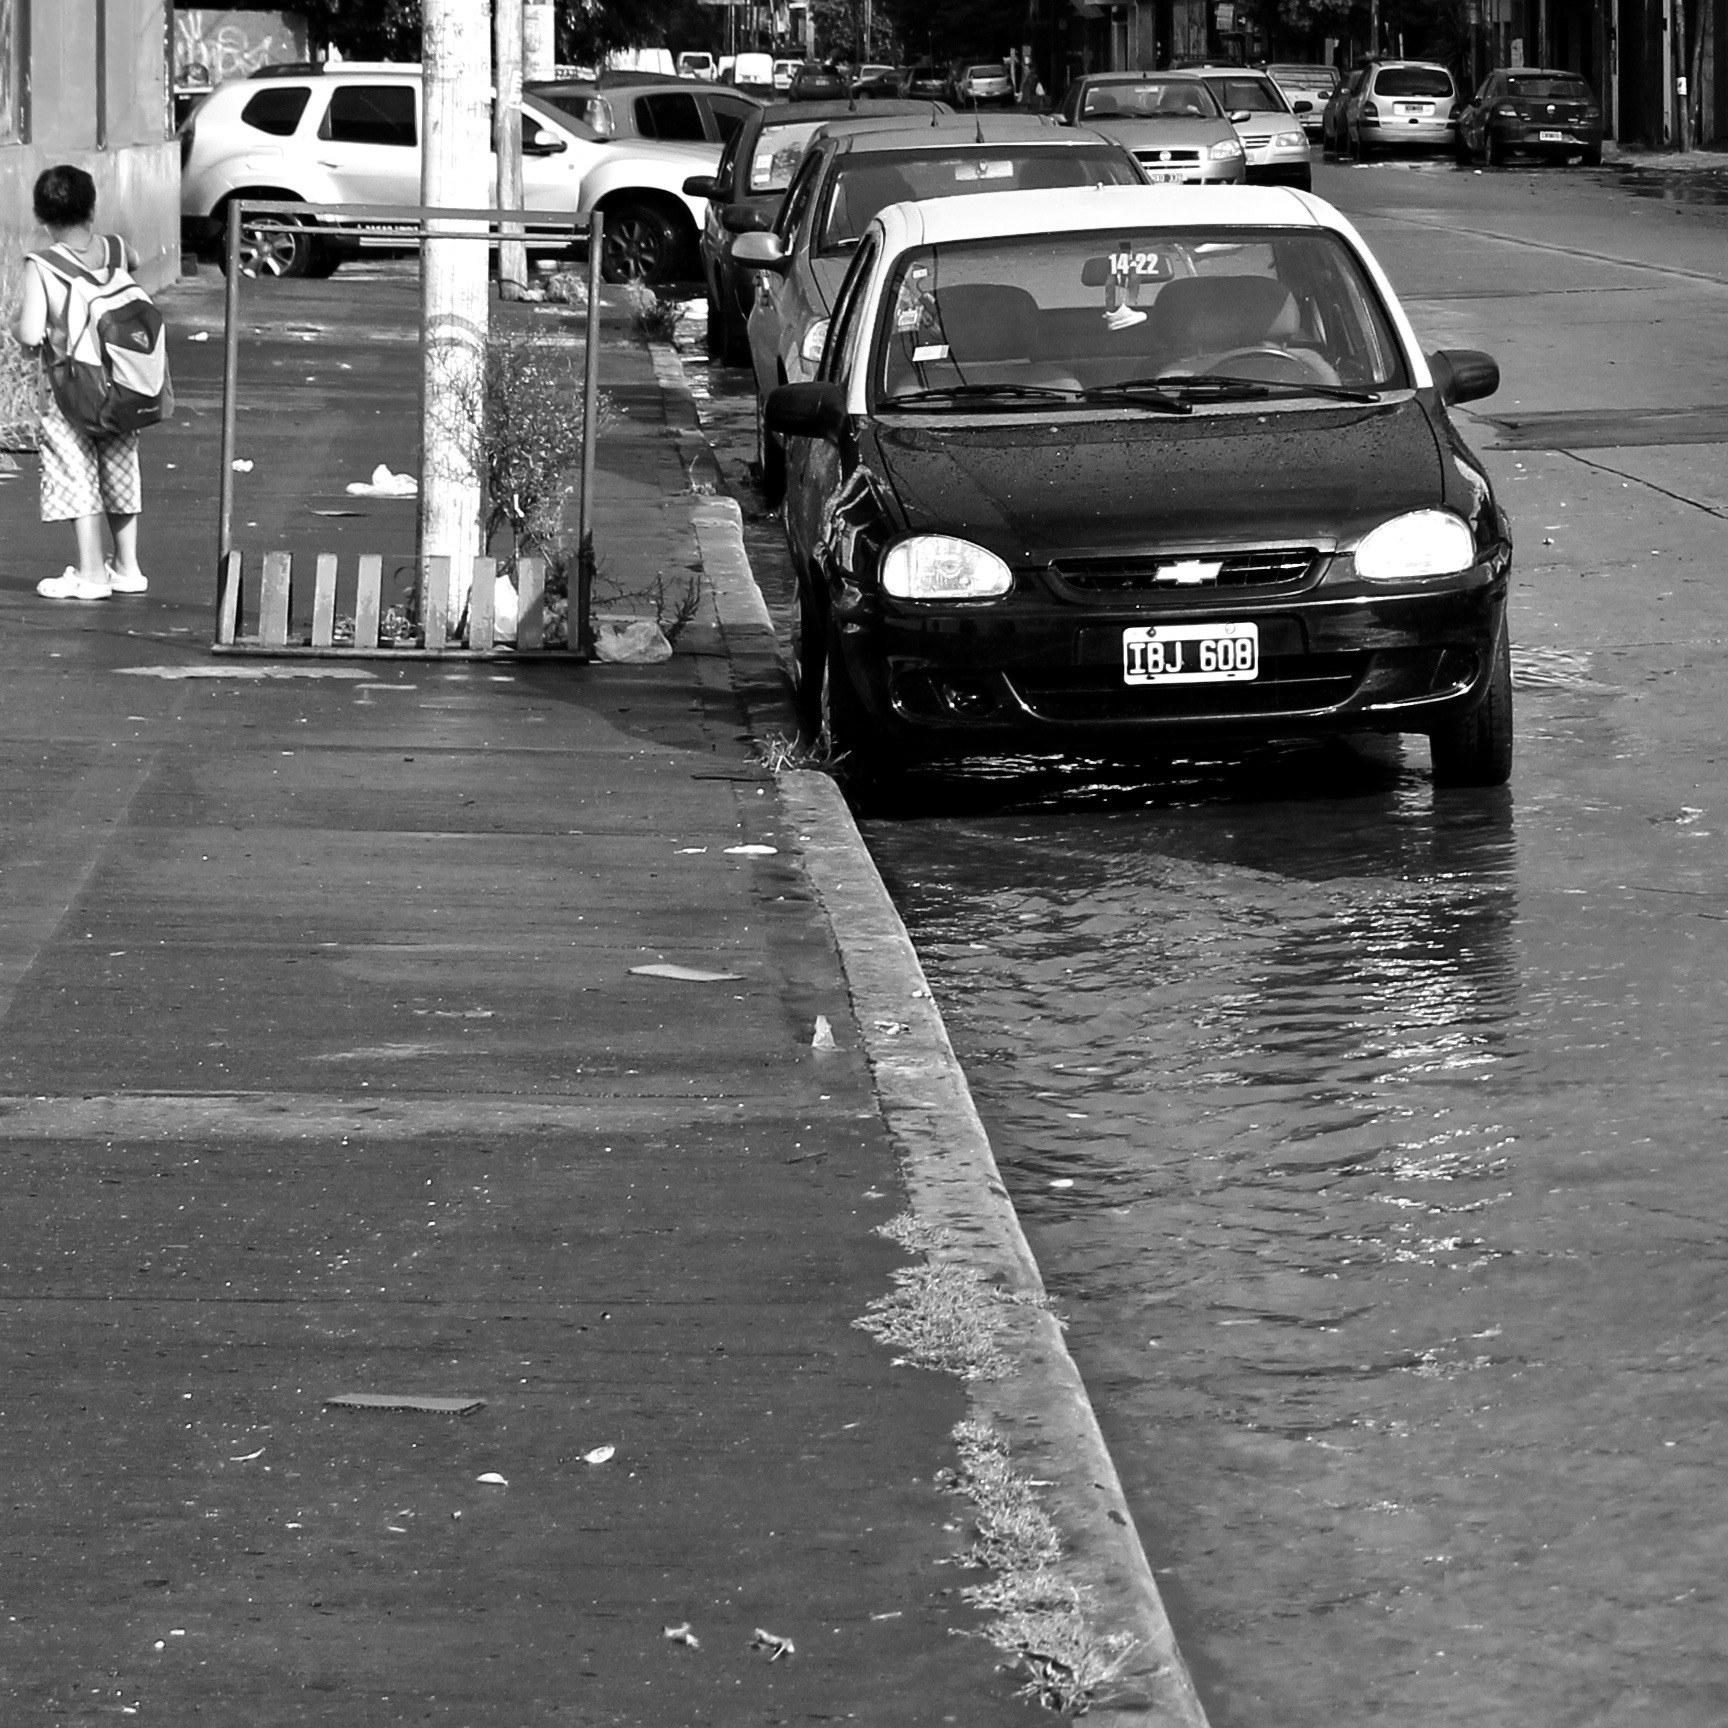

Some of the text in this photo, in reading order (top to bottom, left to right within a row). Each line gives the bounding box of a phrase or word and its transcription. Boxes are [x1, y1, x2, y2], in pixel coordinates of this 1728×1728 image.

[1108, 253, 1160, 274] 14-22
[1129, 638, 1252, 674] IBJ 608
